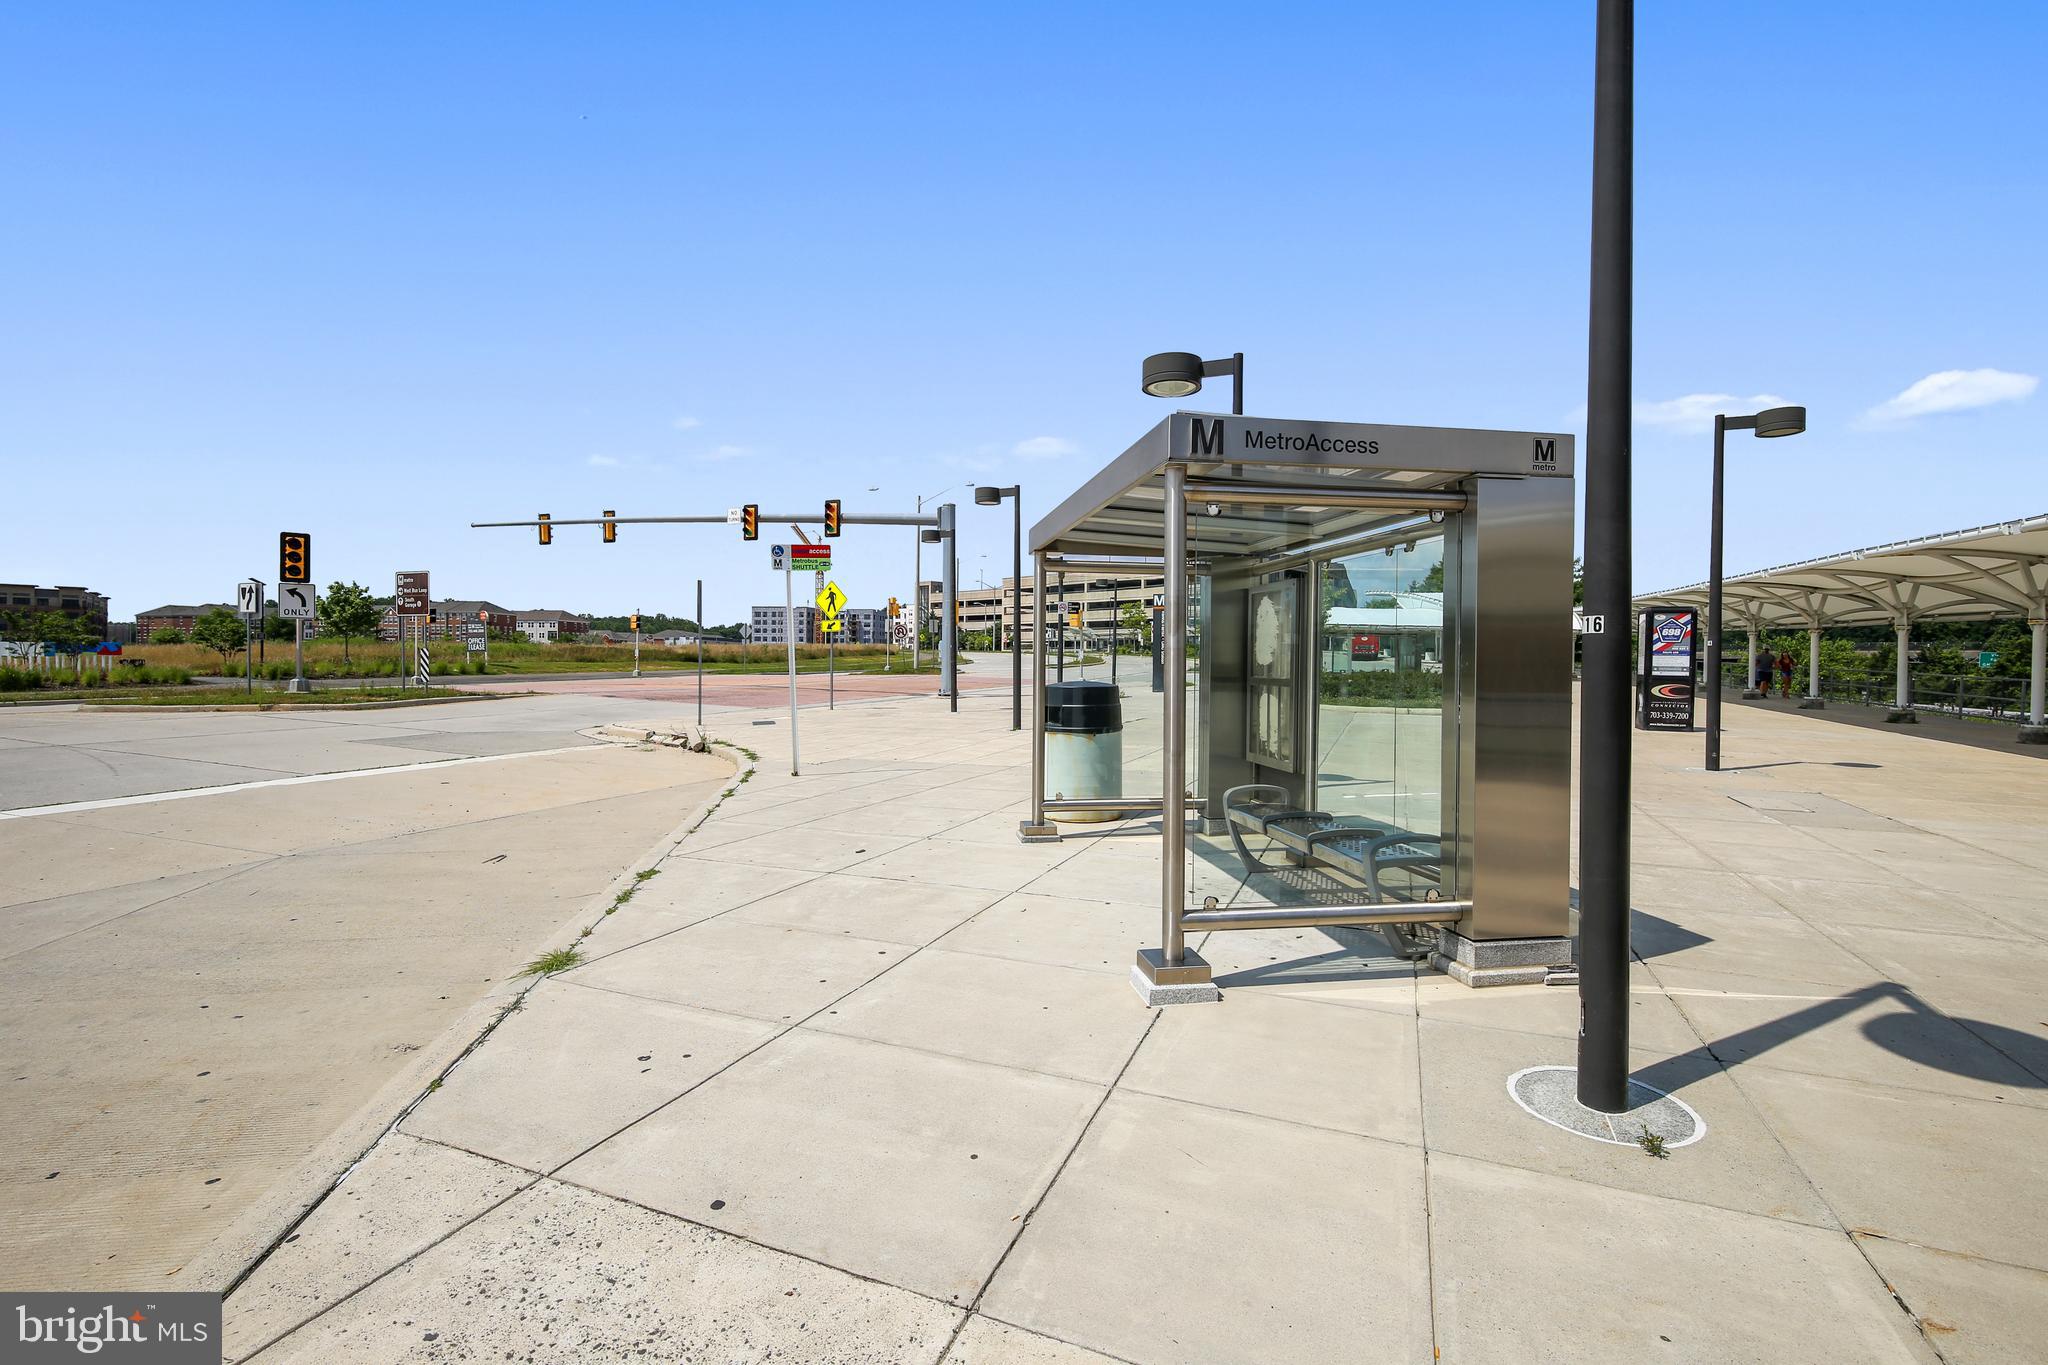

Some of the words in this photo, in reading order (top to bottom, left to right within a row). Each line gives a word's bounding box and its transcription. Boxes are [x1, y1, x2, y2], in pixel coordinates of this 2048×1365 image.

[1191, 418, 1225, 456] M
[1245, 430, 1380, 454] MetroAccess
[1534, 439, 1555, 462] M
[1153, 595, 1165, 606] M
[283, 608, 310, 616] ONLY
[1585, 616, 1603, 633] 16
[1661, 628, 1681, 636] 698
[1649, 711, 1689, 720] 703-339-7200
